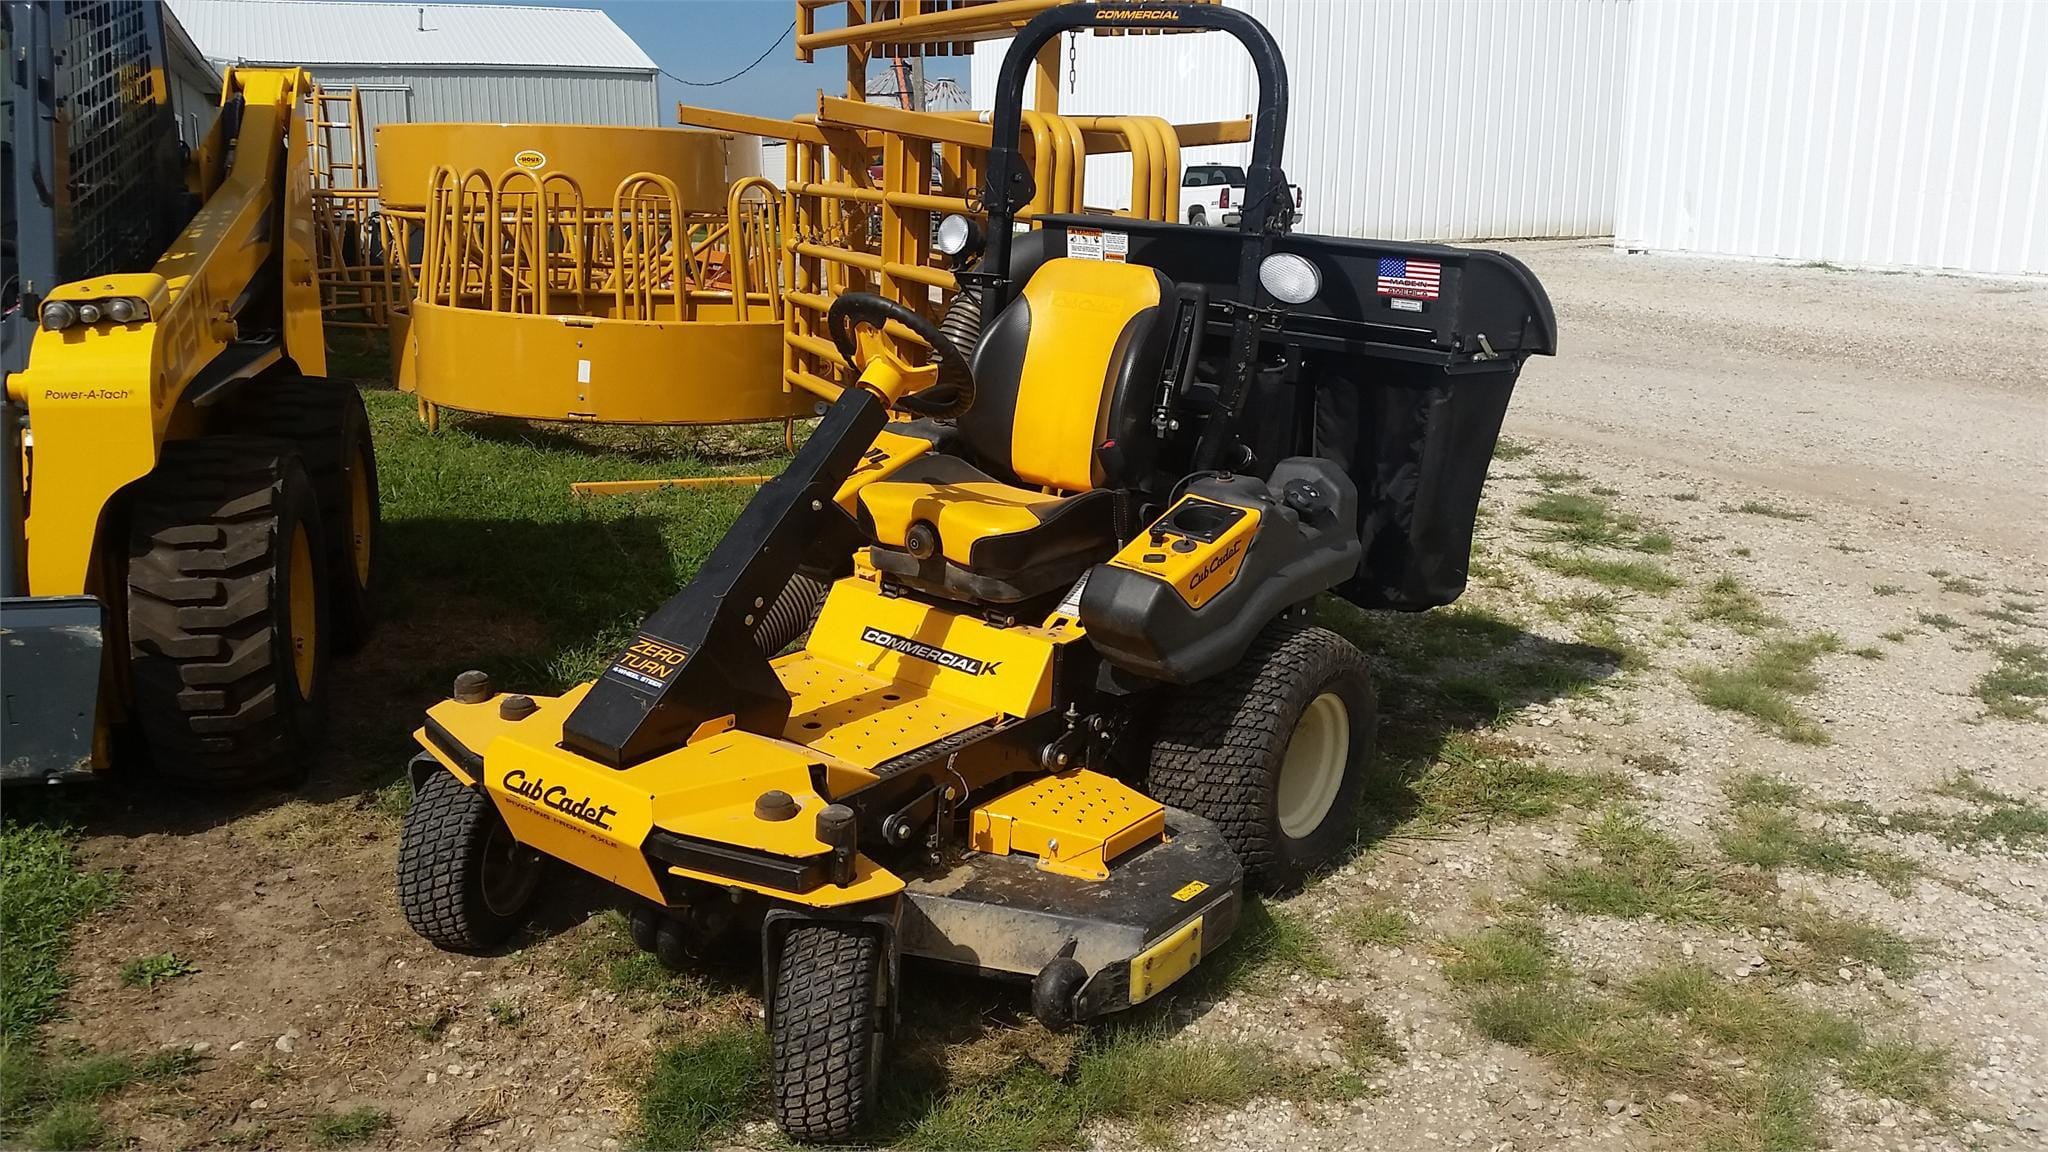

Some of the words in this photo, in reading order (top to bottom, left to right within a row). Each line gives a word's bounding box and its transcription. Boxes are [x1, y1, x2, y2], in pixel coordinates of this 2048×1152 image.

[1095, 10, 1180, 20] COMMERCIAL
[1386, 288, 1428, 297] AMERICA
[1389, 278, 1416, 287] MADE
[1189, 565, 1210, 590] Cub
[1209, 539, 1242, 574] Cadet
[619, 652, 675, 679] TURN
[629, 639, 686, 665] ZERO
[863, 629, 980, 674] COMMERCIAL
[980, 661, 1003, 676] K
[503, 769, 544, 801] Cub
[543, 785, 618, 830] Cadet
[505, 797, 551, 820] PIVOTING
[553, 817, 588, 836] FRONT
[590, 834, 619, 849] AXLE
